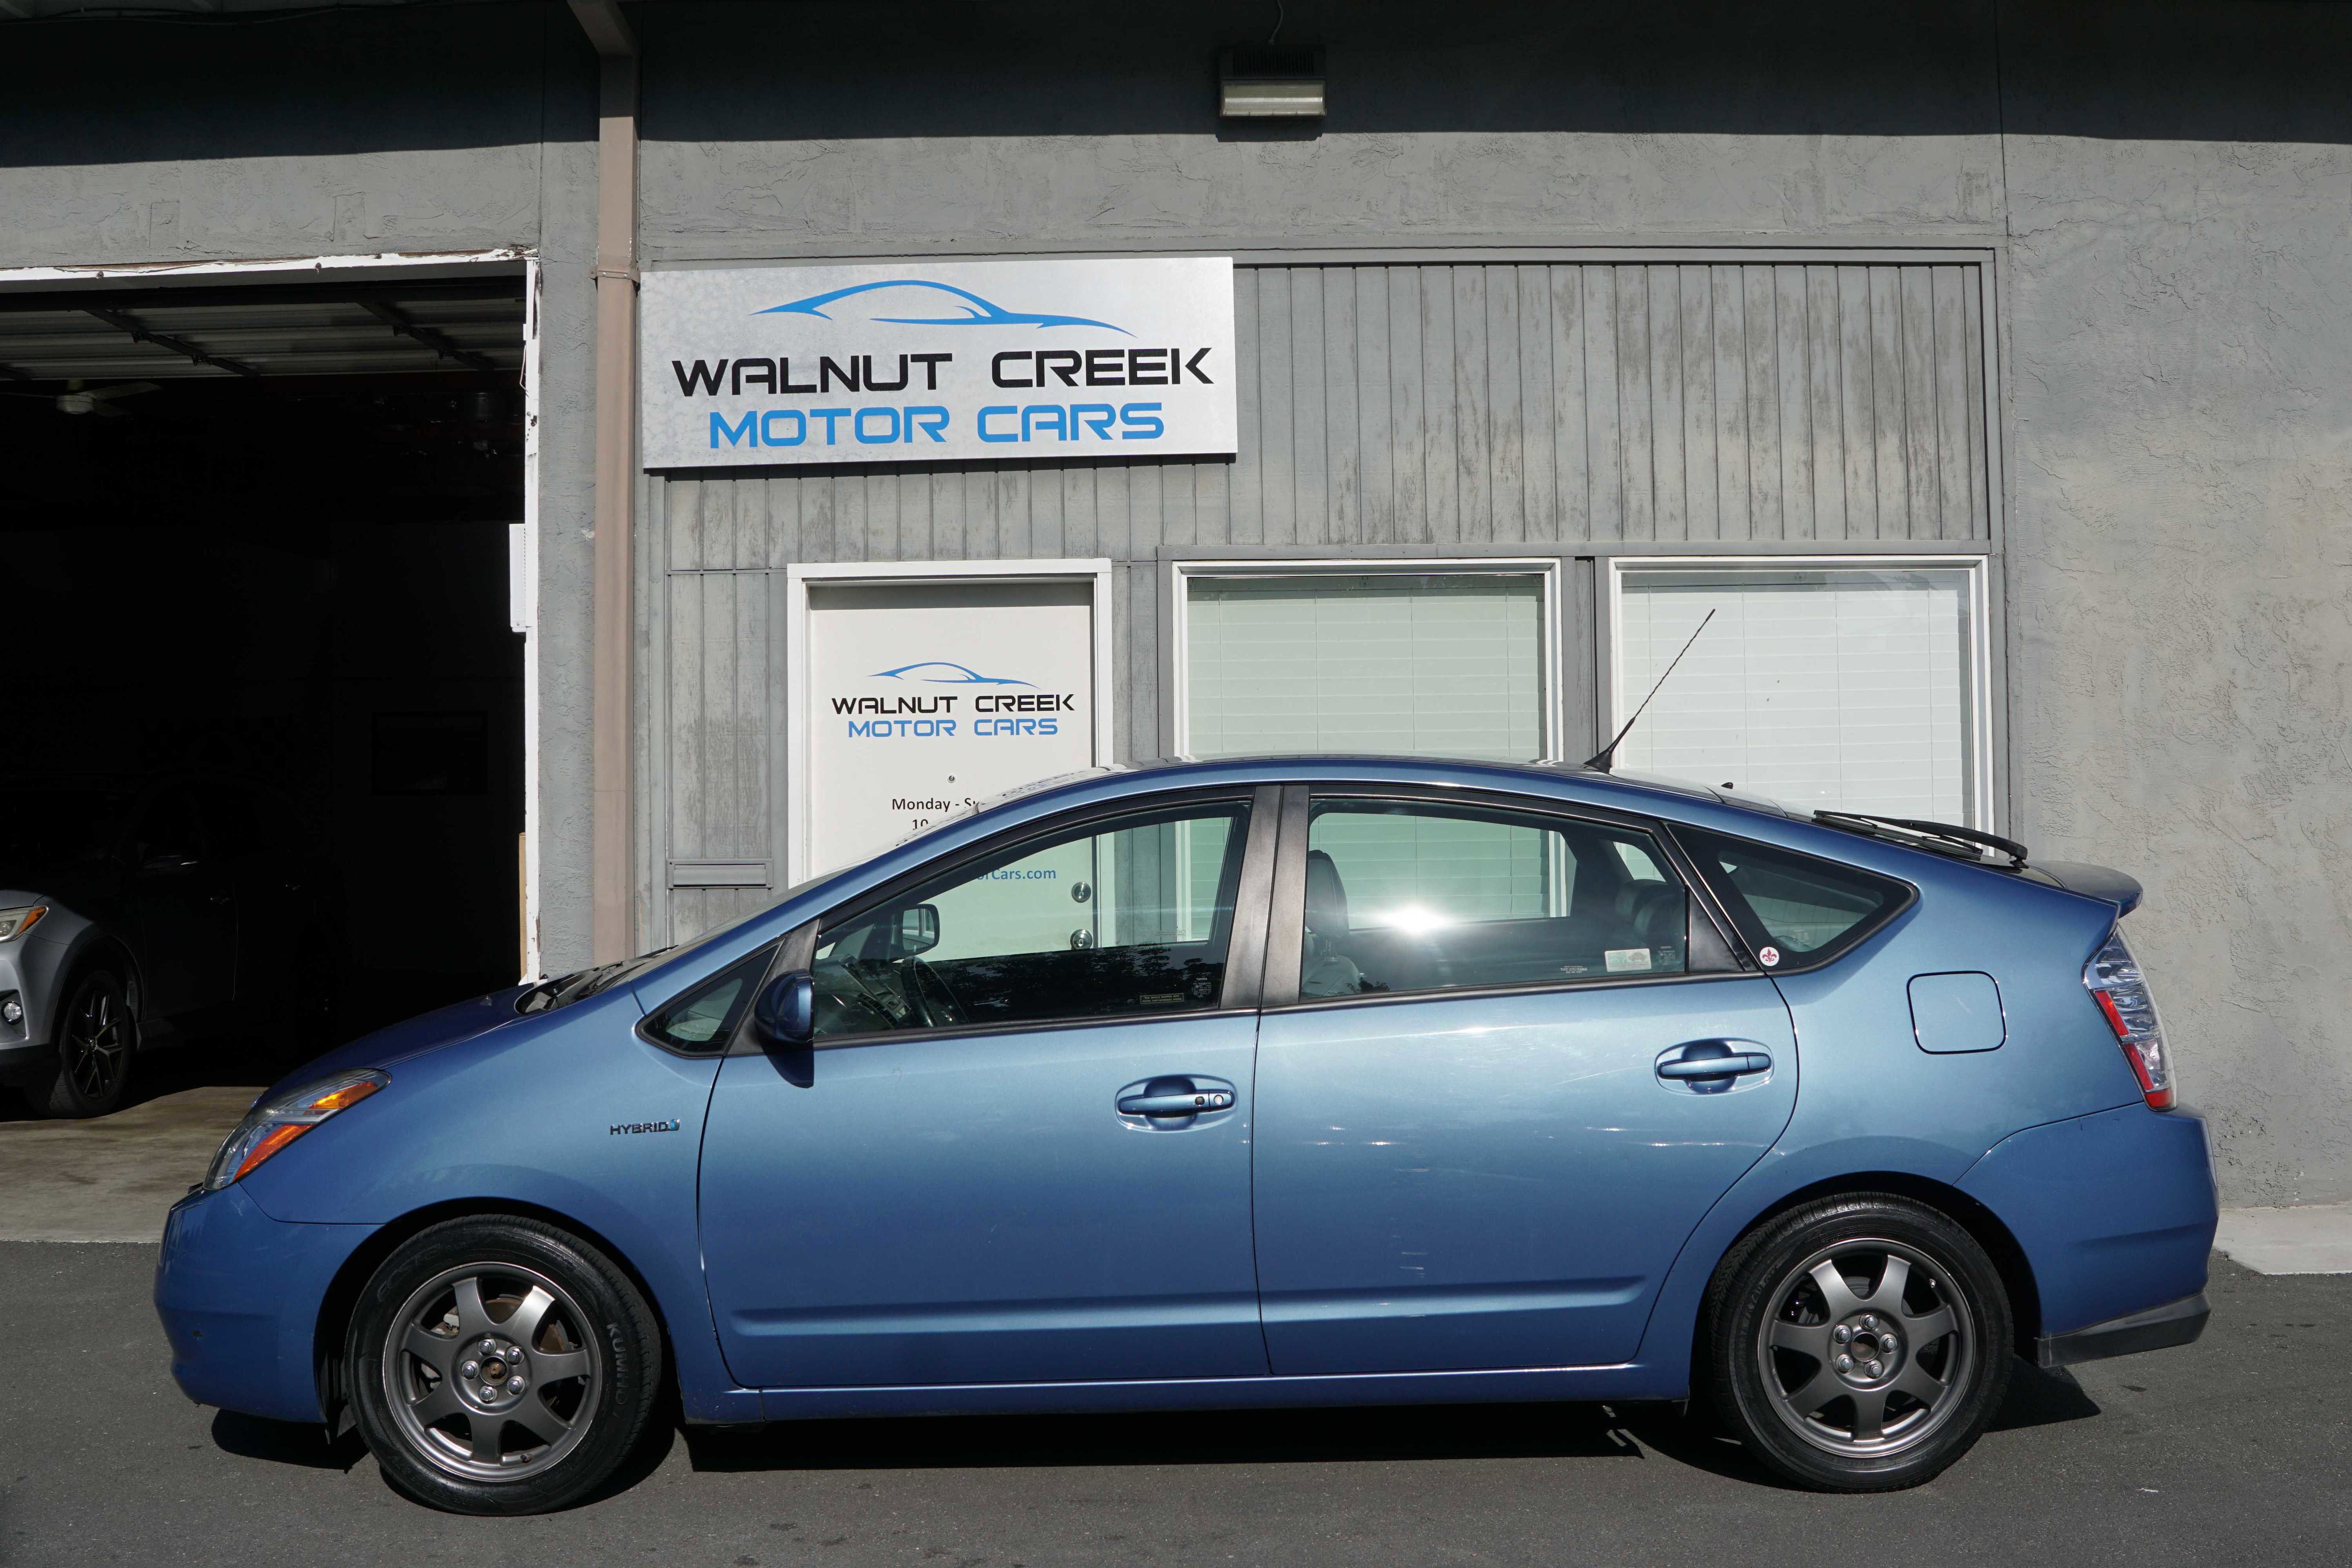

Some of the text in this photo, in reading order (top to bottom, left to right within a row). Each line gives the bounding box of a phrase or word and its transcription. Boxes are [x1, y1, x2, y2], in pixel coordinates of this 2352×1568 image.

[672, 347, 1214, 397] WALNUT CREEK
[709, 402, 1165, 449] MOTOR CARS
[832, 694, 1075, 715] WALNUT CREEK
[848, 718, 1058, 737] MOTOR CARS
[892, 797, 951, 812] Monday
[964, 797, 976, 809] S
[977, 869, 1056, 880] Cars.com
[610, 1122, 669, 1135] HYBRID
[606, 1322, 629, 1405] KUMHO
